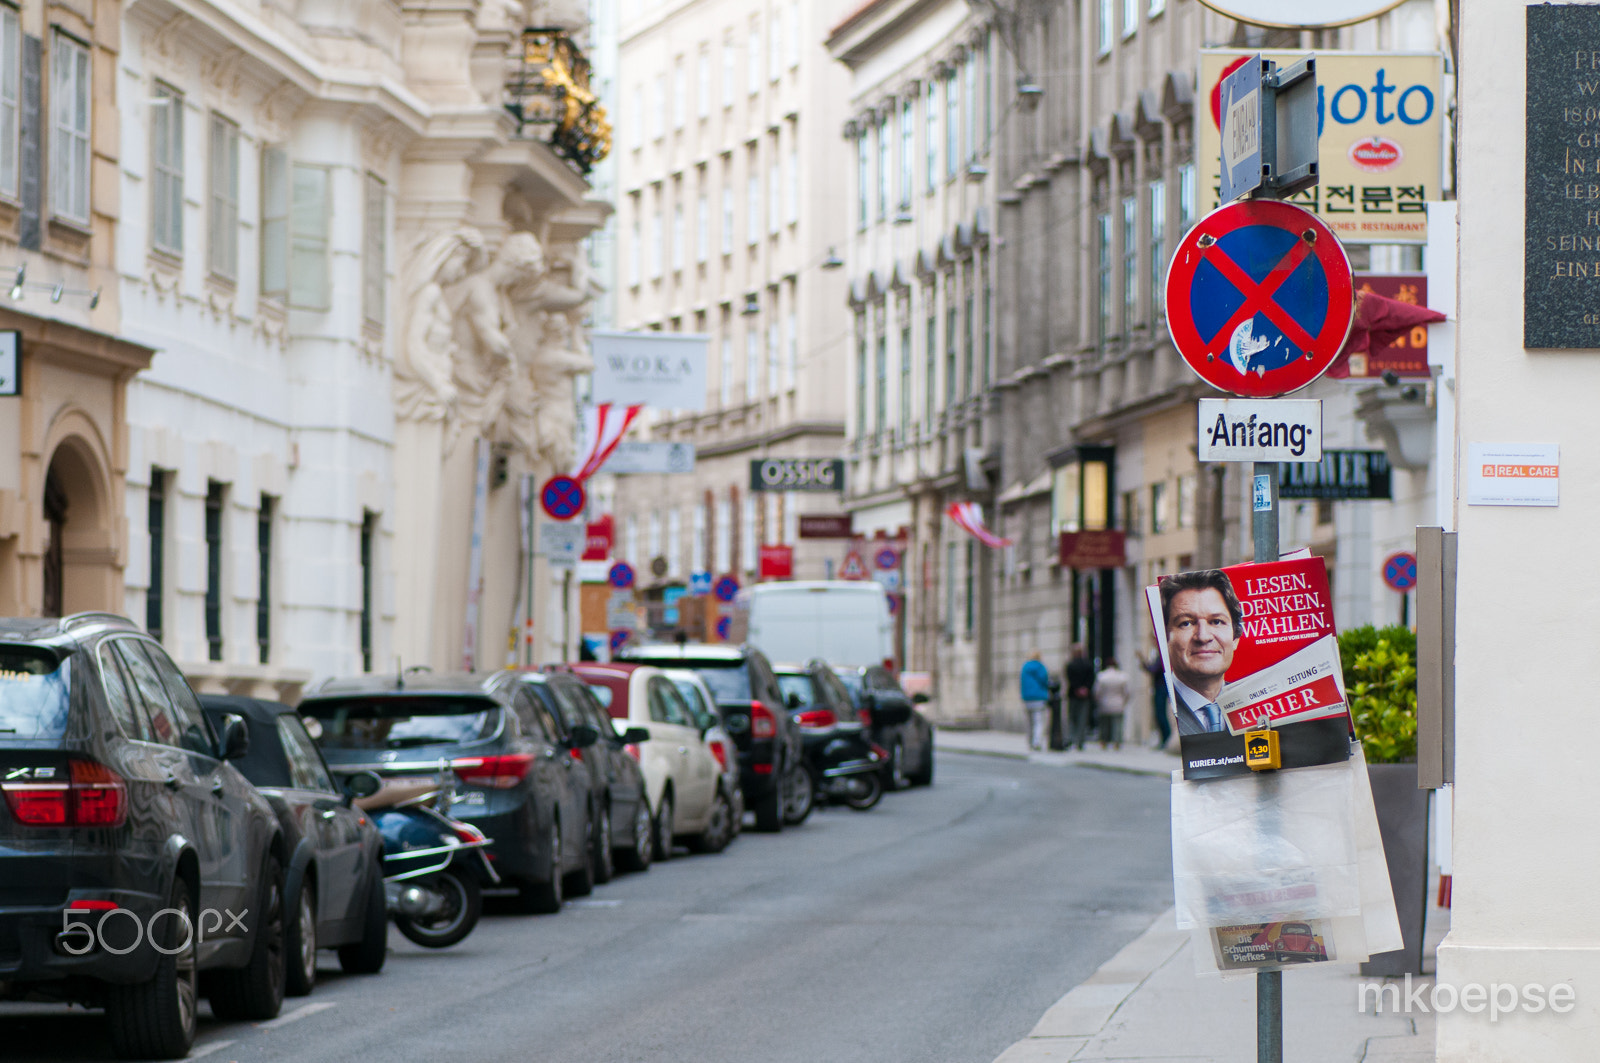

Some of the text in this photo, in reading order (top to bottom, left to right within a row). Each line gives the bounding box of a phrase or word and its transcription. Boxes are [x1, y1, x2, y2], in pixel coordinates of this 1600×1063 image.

[1564, 106, 1600, 122] 180
[1292, 184, 1426, 214] 식전문점
[1361, 222, 1425, 232] RESTAURANT
[607, 354, 692, 375] WOKA
[760, 459, 835, 485] OSSIG
[1498, 466, 1556, 476] REAL CARE
[1245, 573, 1312, 596] LESEN.
[1239, 592, 1325, 618] DENKEN.
[1239, 612, 1330, 638] WÄHLEN.
[1287, 666, 1318, 685] ZEITUNG
[1249, 687, 1268, 700] ONLINE
[1238, 688, 1320, 725] KURIER
[1189, 755, 1244, 768] KURIER.at/wahl
[6, 767, 56, 779] X5
[1238, 935, 1252, 943] Die
[1223, 943, 1271, 954] Schummel-
[1232, 953, 1266, 962] Piefkes
